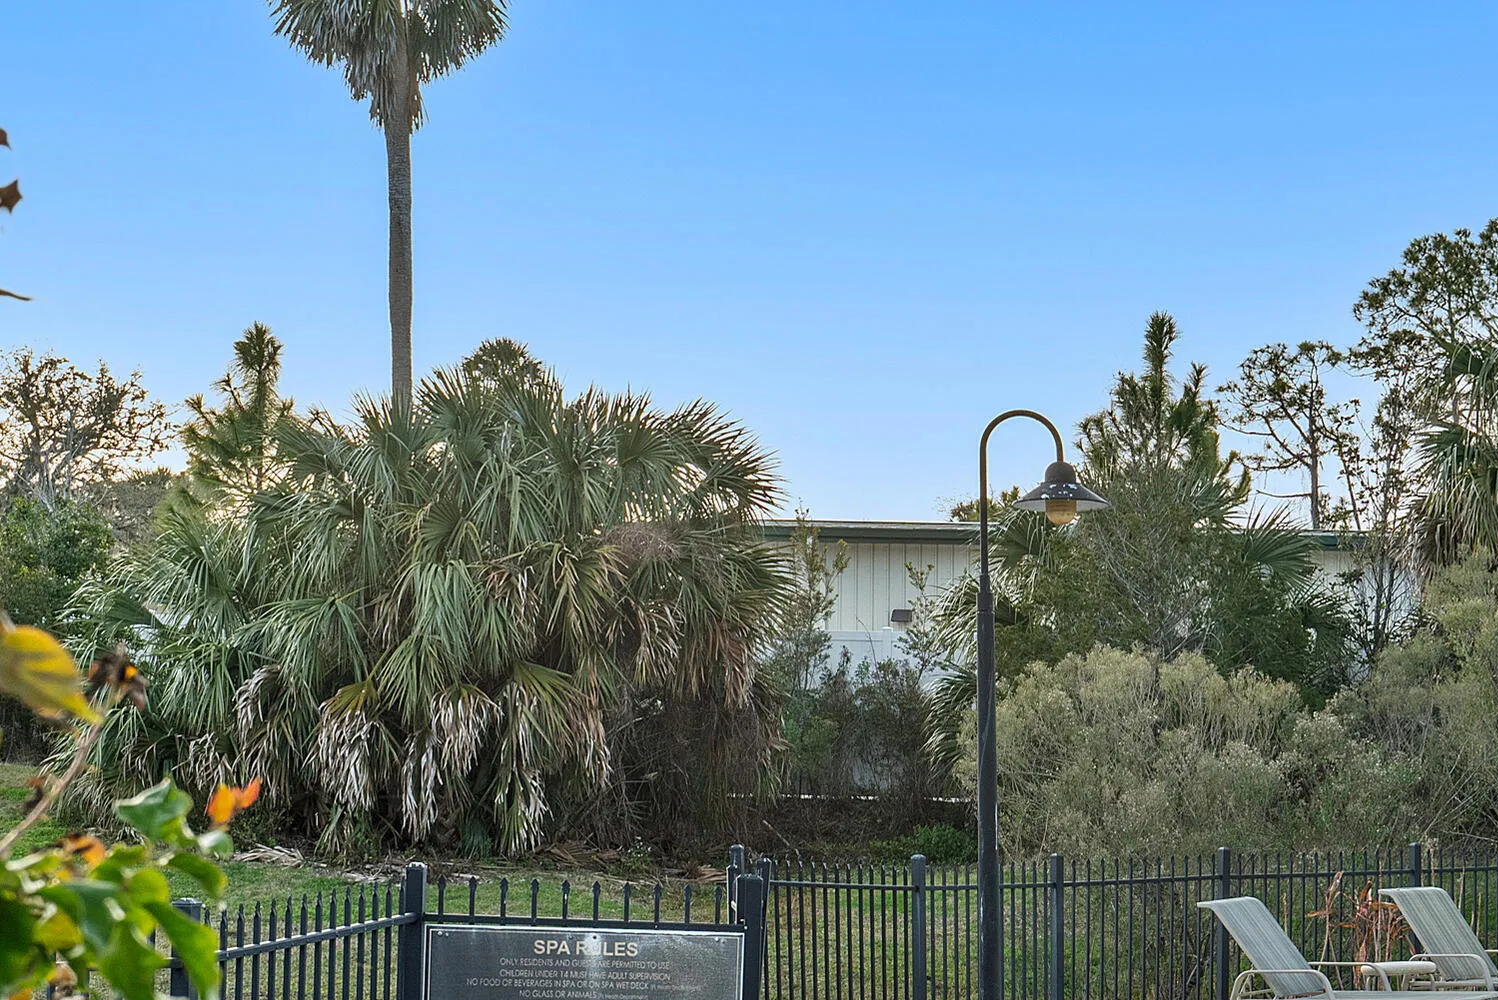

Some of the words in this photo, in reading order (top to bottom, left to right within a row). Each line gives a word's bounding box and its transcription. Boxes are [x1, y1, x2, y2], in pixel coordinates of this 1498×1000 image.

[533, 939, 570, 955] SPA
[500, 969, 534, 978] CHILDREN
[535, 970, 558, 978] UNDER
[560, 970, 568, 979] 14
[569, 970, 588, 979] MUST
[608, 971, 628, 980] ADULT
[629, 972, 671, 981] SUPERVISION
[466, 978, 478, 986] NO
[479, 978, 500, 987] FOOD
[502, 979, 512, 987] OR
[514, 979, 553, 988] BEVERAGES
[554, 980, 562, 988] IN
[562, 980, 575, 988] SPA
[576, 980, 588, 989] OR
[589, 981, 600, 989] ON
[601, 981, 614, 989] SPA
[616, 981, 629, 990] WET
[630, 981, 648, 990] DECK
[519, 990, 530, 998] NO
[532, 990, 554, 998] GLASS
[555, 991, 565, 999] OR
[567, 991, 597, 999] ANIMALS
